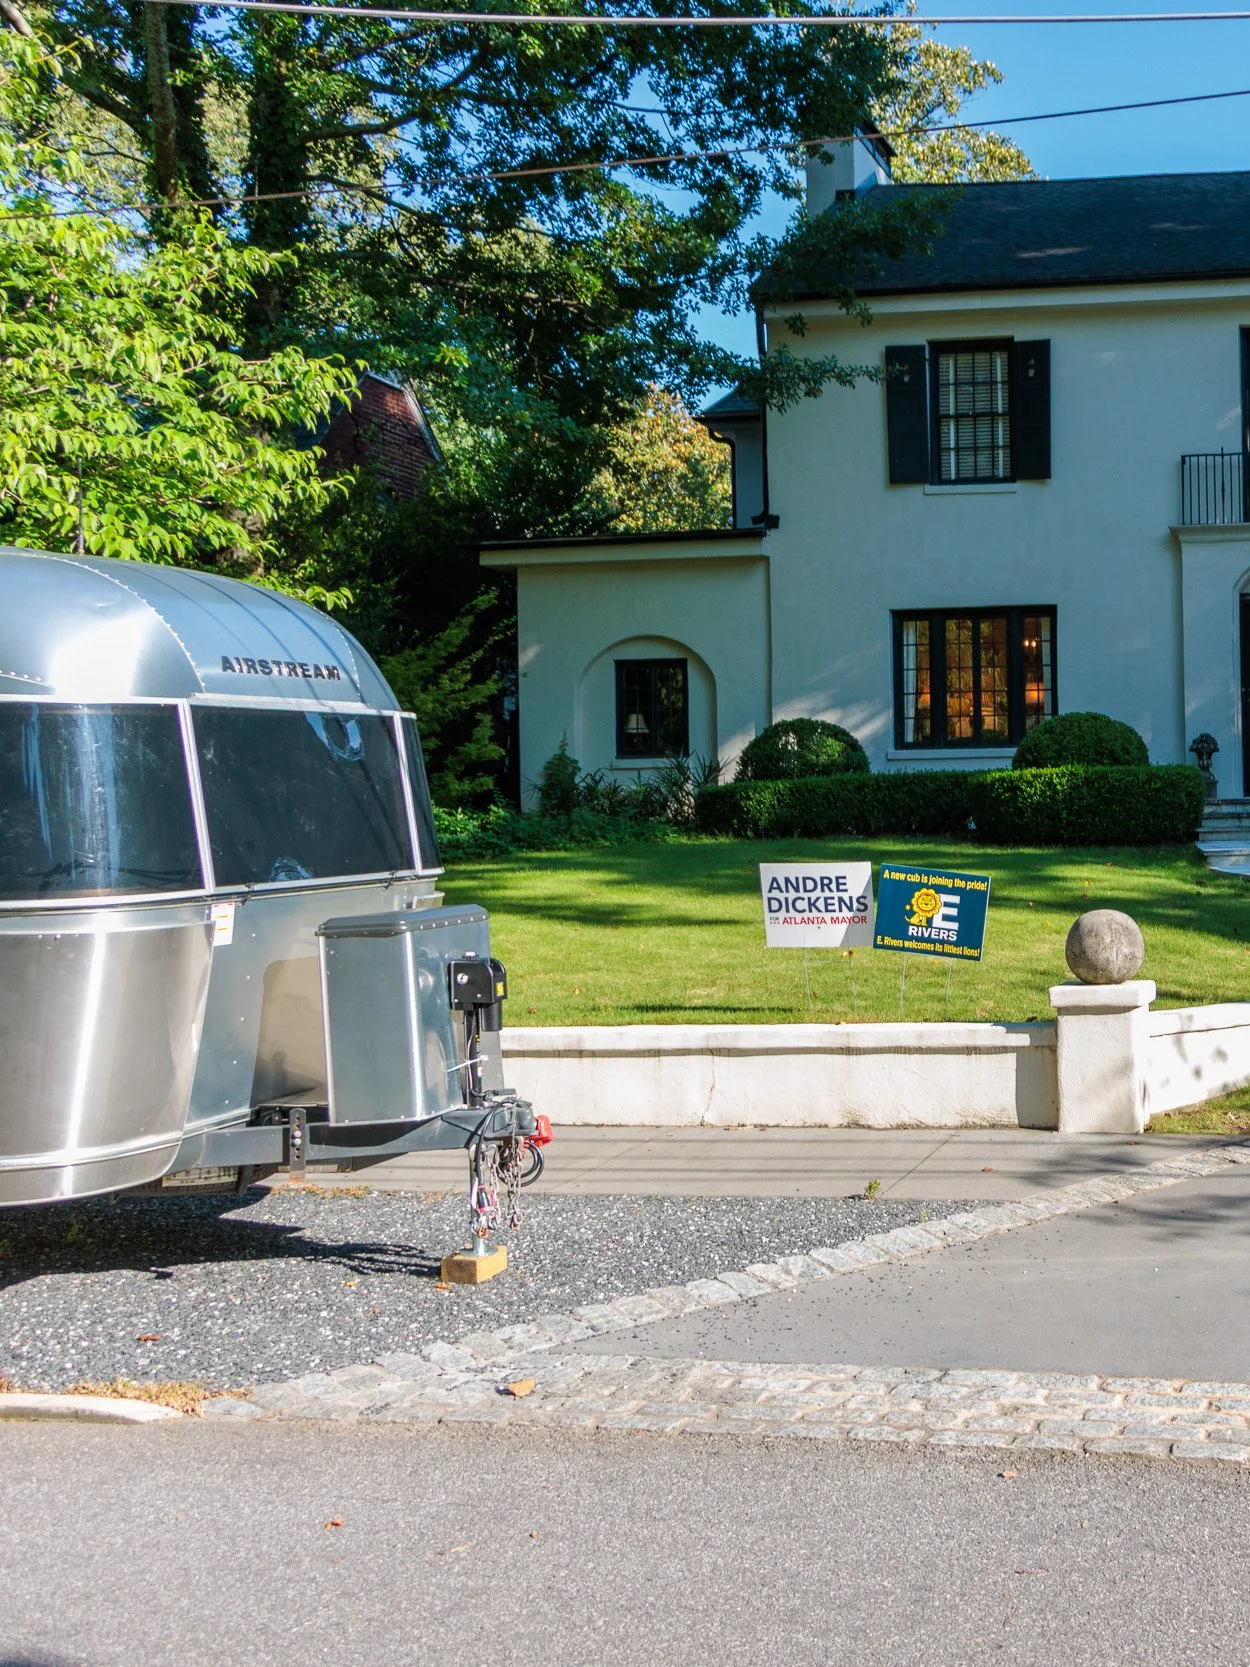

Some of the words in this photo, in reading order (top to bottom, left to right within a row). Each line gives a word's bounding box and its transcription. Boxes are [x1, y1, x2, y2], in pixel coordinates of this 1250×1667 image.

[221, 656, 341, 681] AIRSTREAM
[768, 876, 848, 893] ANDRE
[883, 869, 890, 879] A
[891, 872, 906, 880] new
[906, 873, 921, 882] cub
[921, 873, 928, 883] is
[928, 875, 953, 888] joining
[954, 877, 966, 888] the
[966, 880, 988, 891] pride!
[767, 895, 869, 913] DICKENS
[932, 893, 961, 930] E
[782, 916, 827, 925] ATLANTA
[830, 915, 867, 925] MAYOR
[908, 925, 958, 941] RIVERS
[876, 935, 883, 945] E.
[884, 936, 903, 947] Rivers
[904, 940, 935, 951] welcomes
[935, 943, 943, 952] its
[943, 944, 963, 954] littlest
[963, 946, 980, 957] lions!
